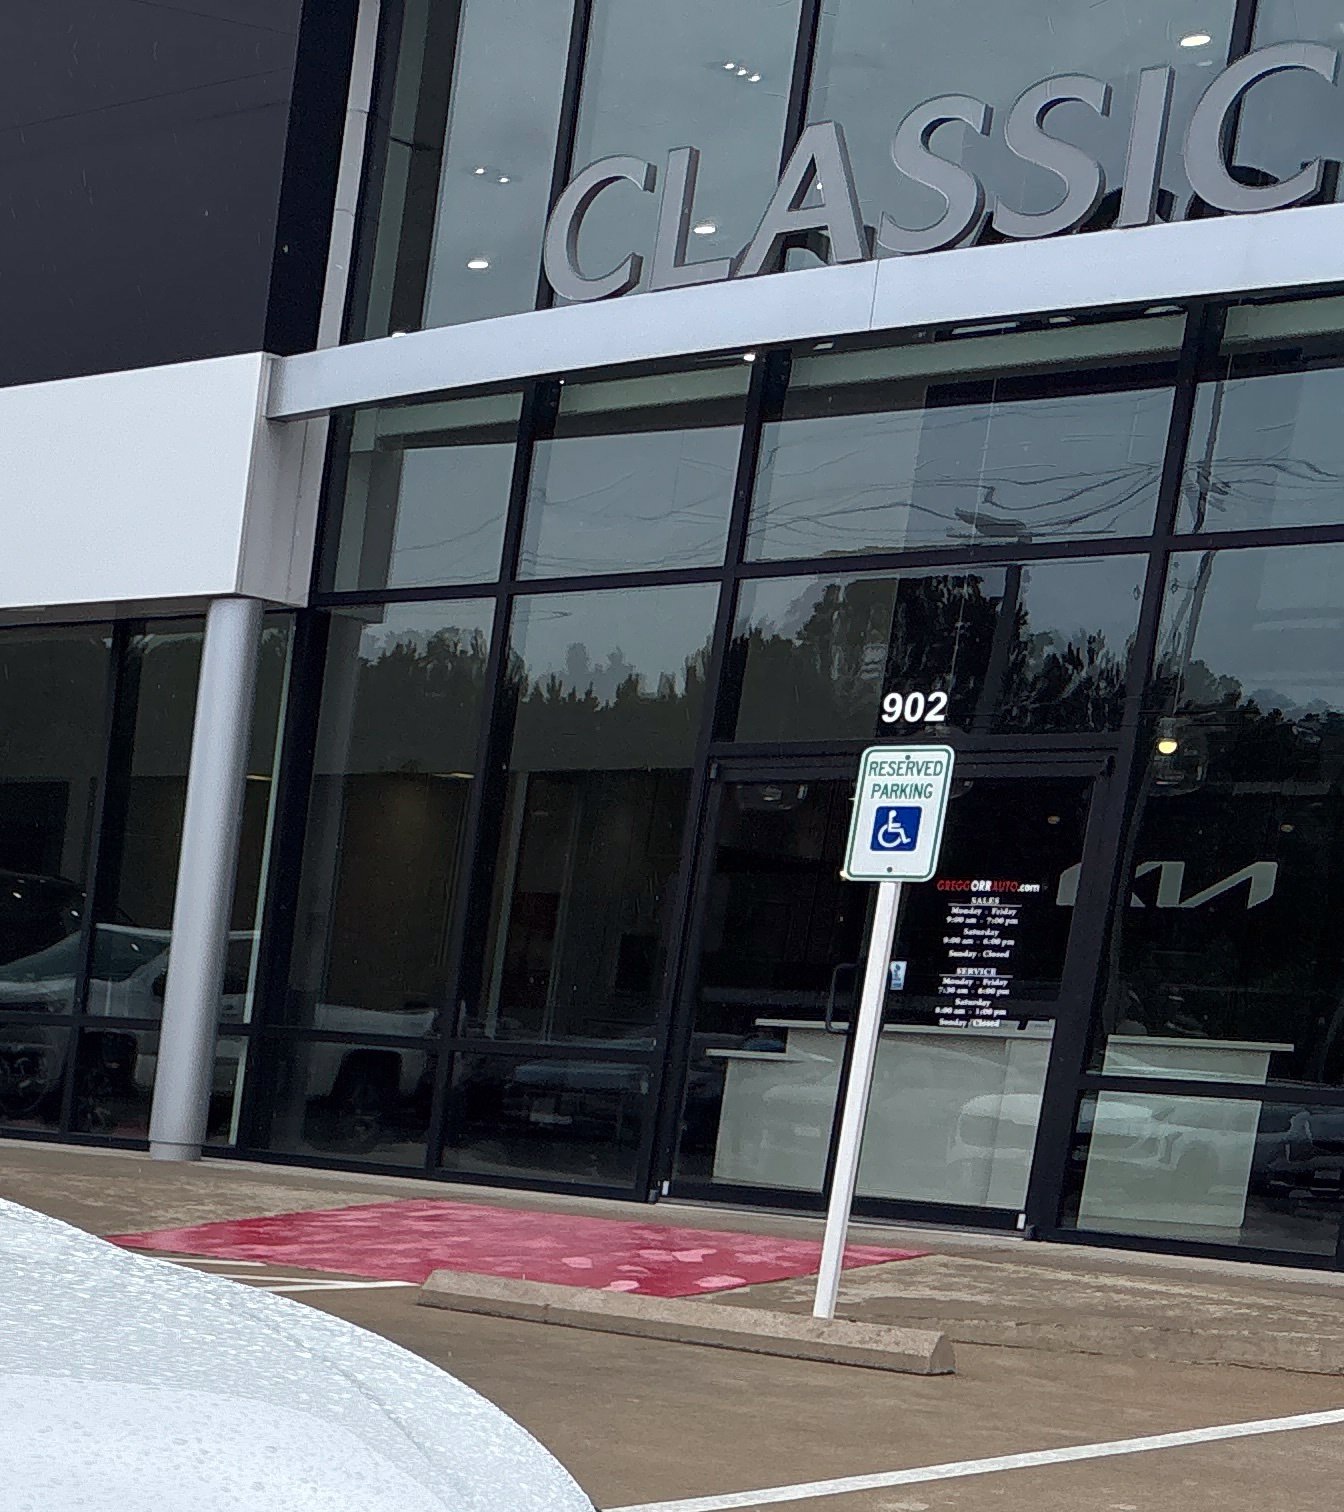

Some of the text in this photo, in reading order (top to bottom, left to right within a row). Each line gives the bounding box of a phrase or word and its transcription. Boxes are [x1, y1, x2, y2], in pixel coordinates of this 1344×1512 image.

[543, 39, 1342, 302] CLASSIC
[881, 690, 948, 723] 902
[868, 760, 944, 777] RESERVED
[870, 783, 934, 800] PARKING
[951, 907, 982, 917] Monday
[991, 907, 1017, 917] Friday
[963, 928, 1000, 937] Saturday
[948, 950, 977, 959] Sunday
[983, 950, 1010, 958] Closed
[956, 967, 997, 976] SERVICE
[942, 978, 974, 987] Monday
[982, 978, 1008, 987] Friday
[955, 998, 992, 1007] Saturday
[939, 1018, 1000, 1027] Sunday Closed
